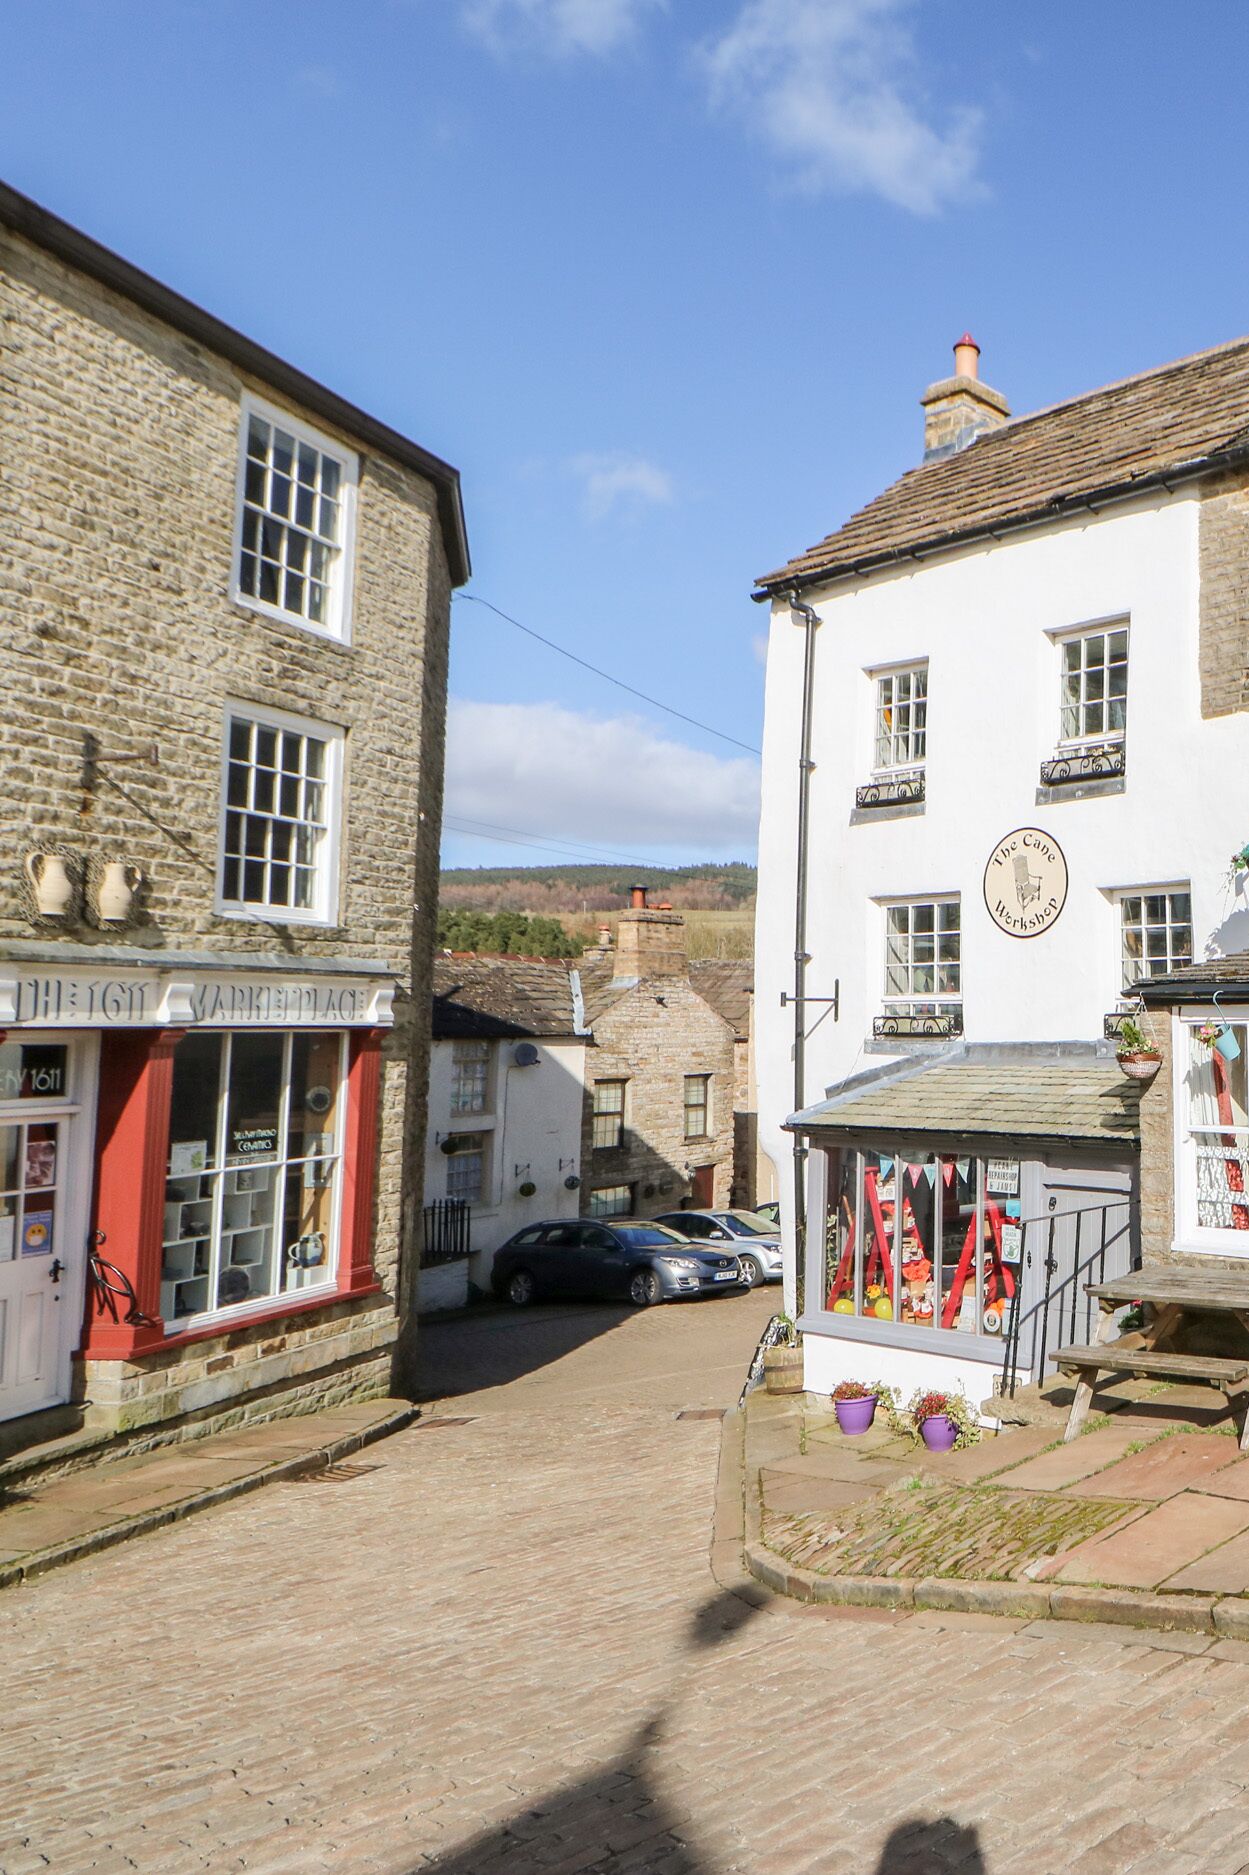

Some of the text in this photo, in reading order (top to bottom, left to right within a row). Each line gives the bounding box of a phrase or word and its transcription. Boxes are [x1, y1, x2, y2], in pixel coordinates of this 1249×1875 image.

[992, 833, 1056, 867] The Cane
[994, 897, 1058, 931] Workshop
[88, 981, 149, 1021] 1611
[30, 1067, 61, 1090] 1611
